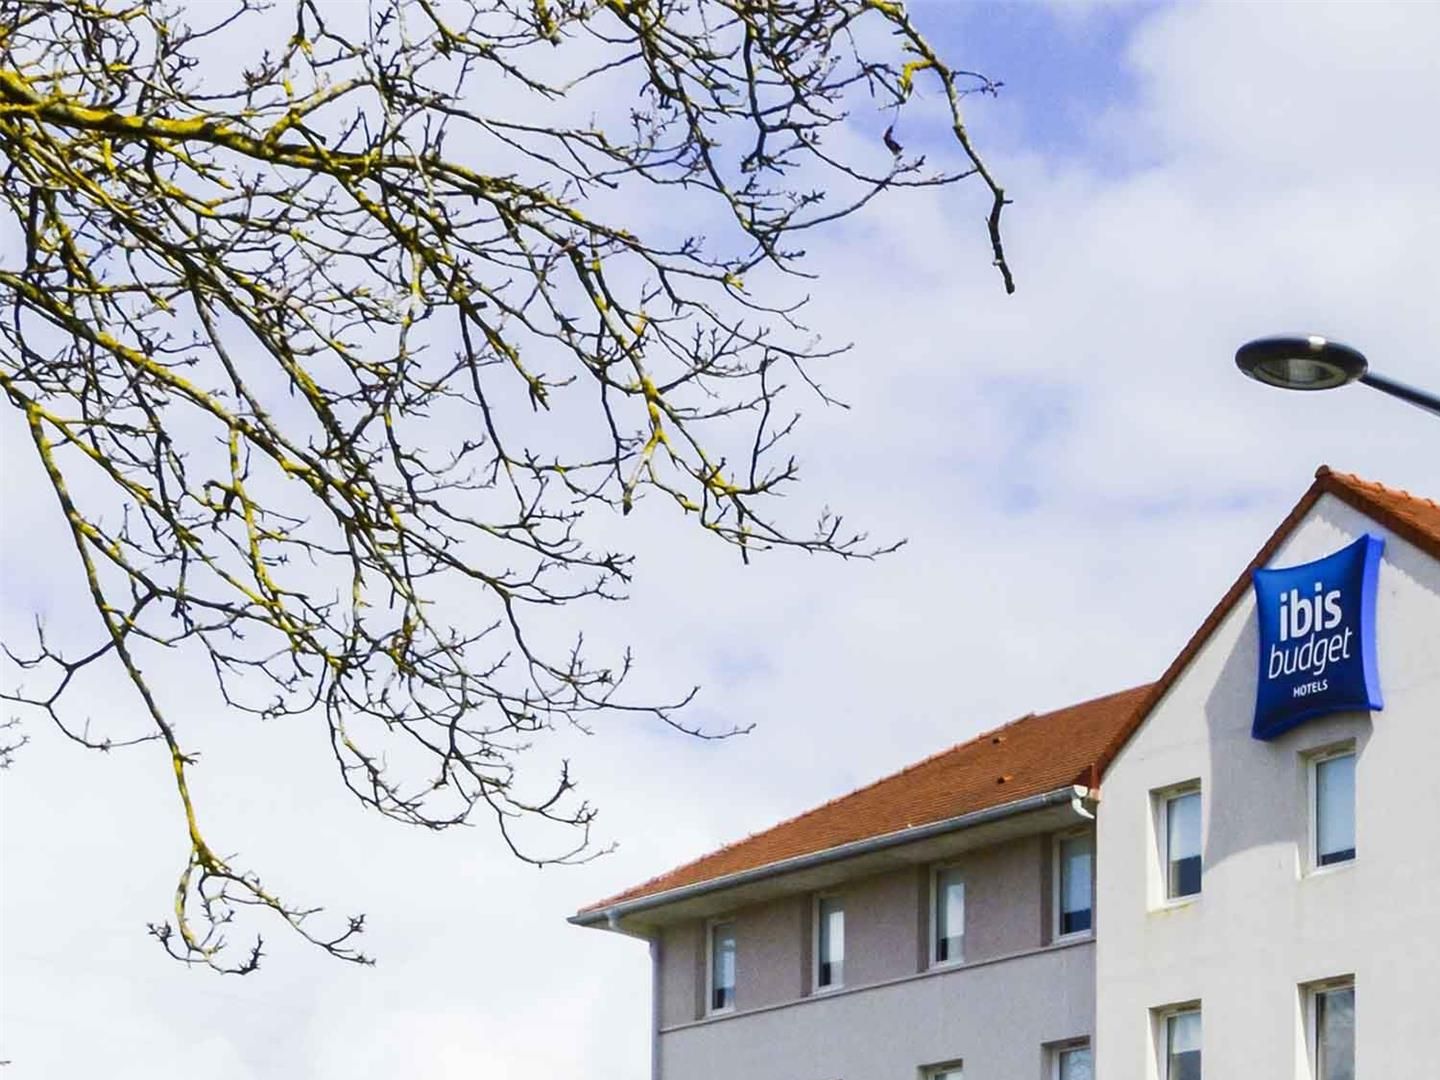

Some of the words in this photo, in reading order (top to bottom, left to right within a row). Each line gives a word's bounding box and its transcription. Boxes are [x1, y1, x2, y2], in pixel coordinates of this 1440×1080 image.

[1279, 581, 1343, 642] ibis
[1268, 626, 1353, 680] budget
[1293, 679, 1329, 698] HOTELS
